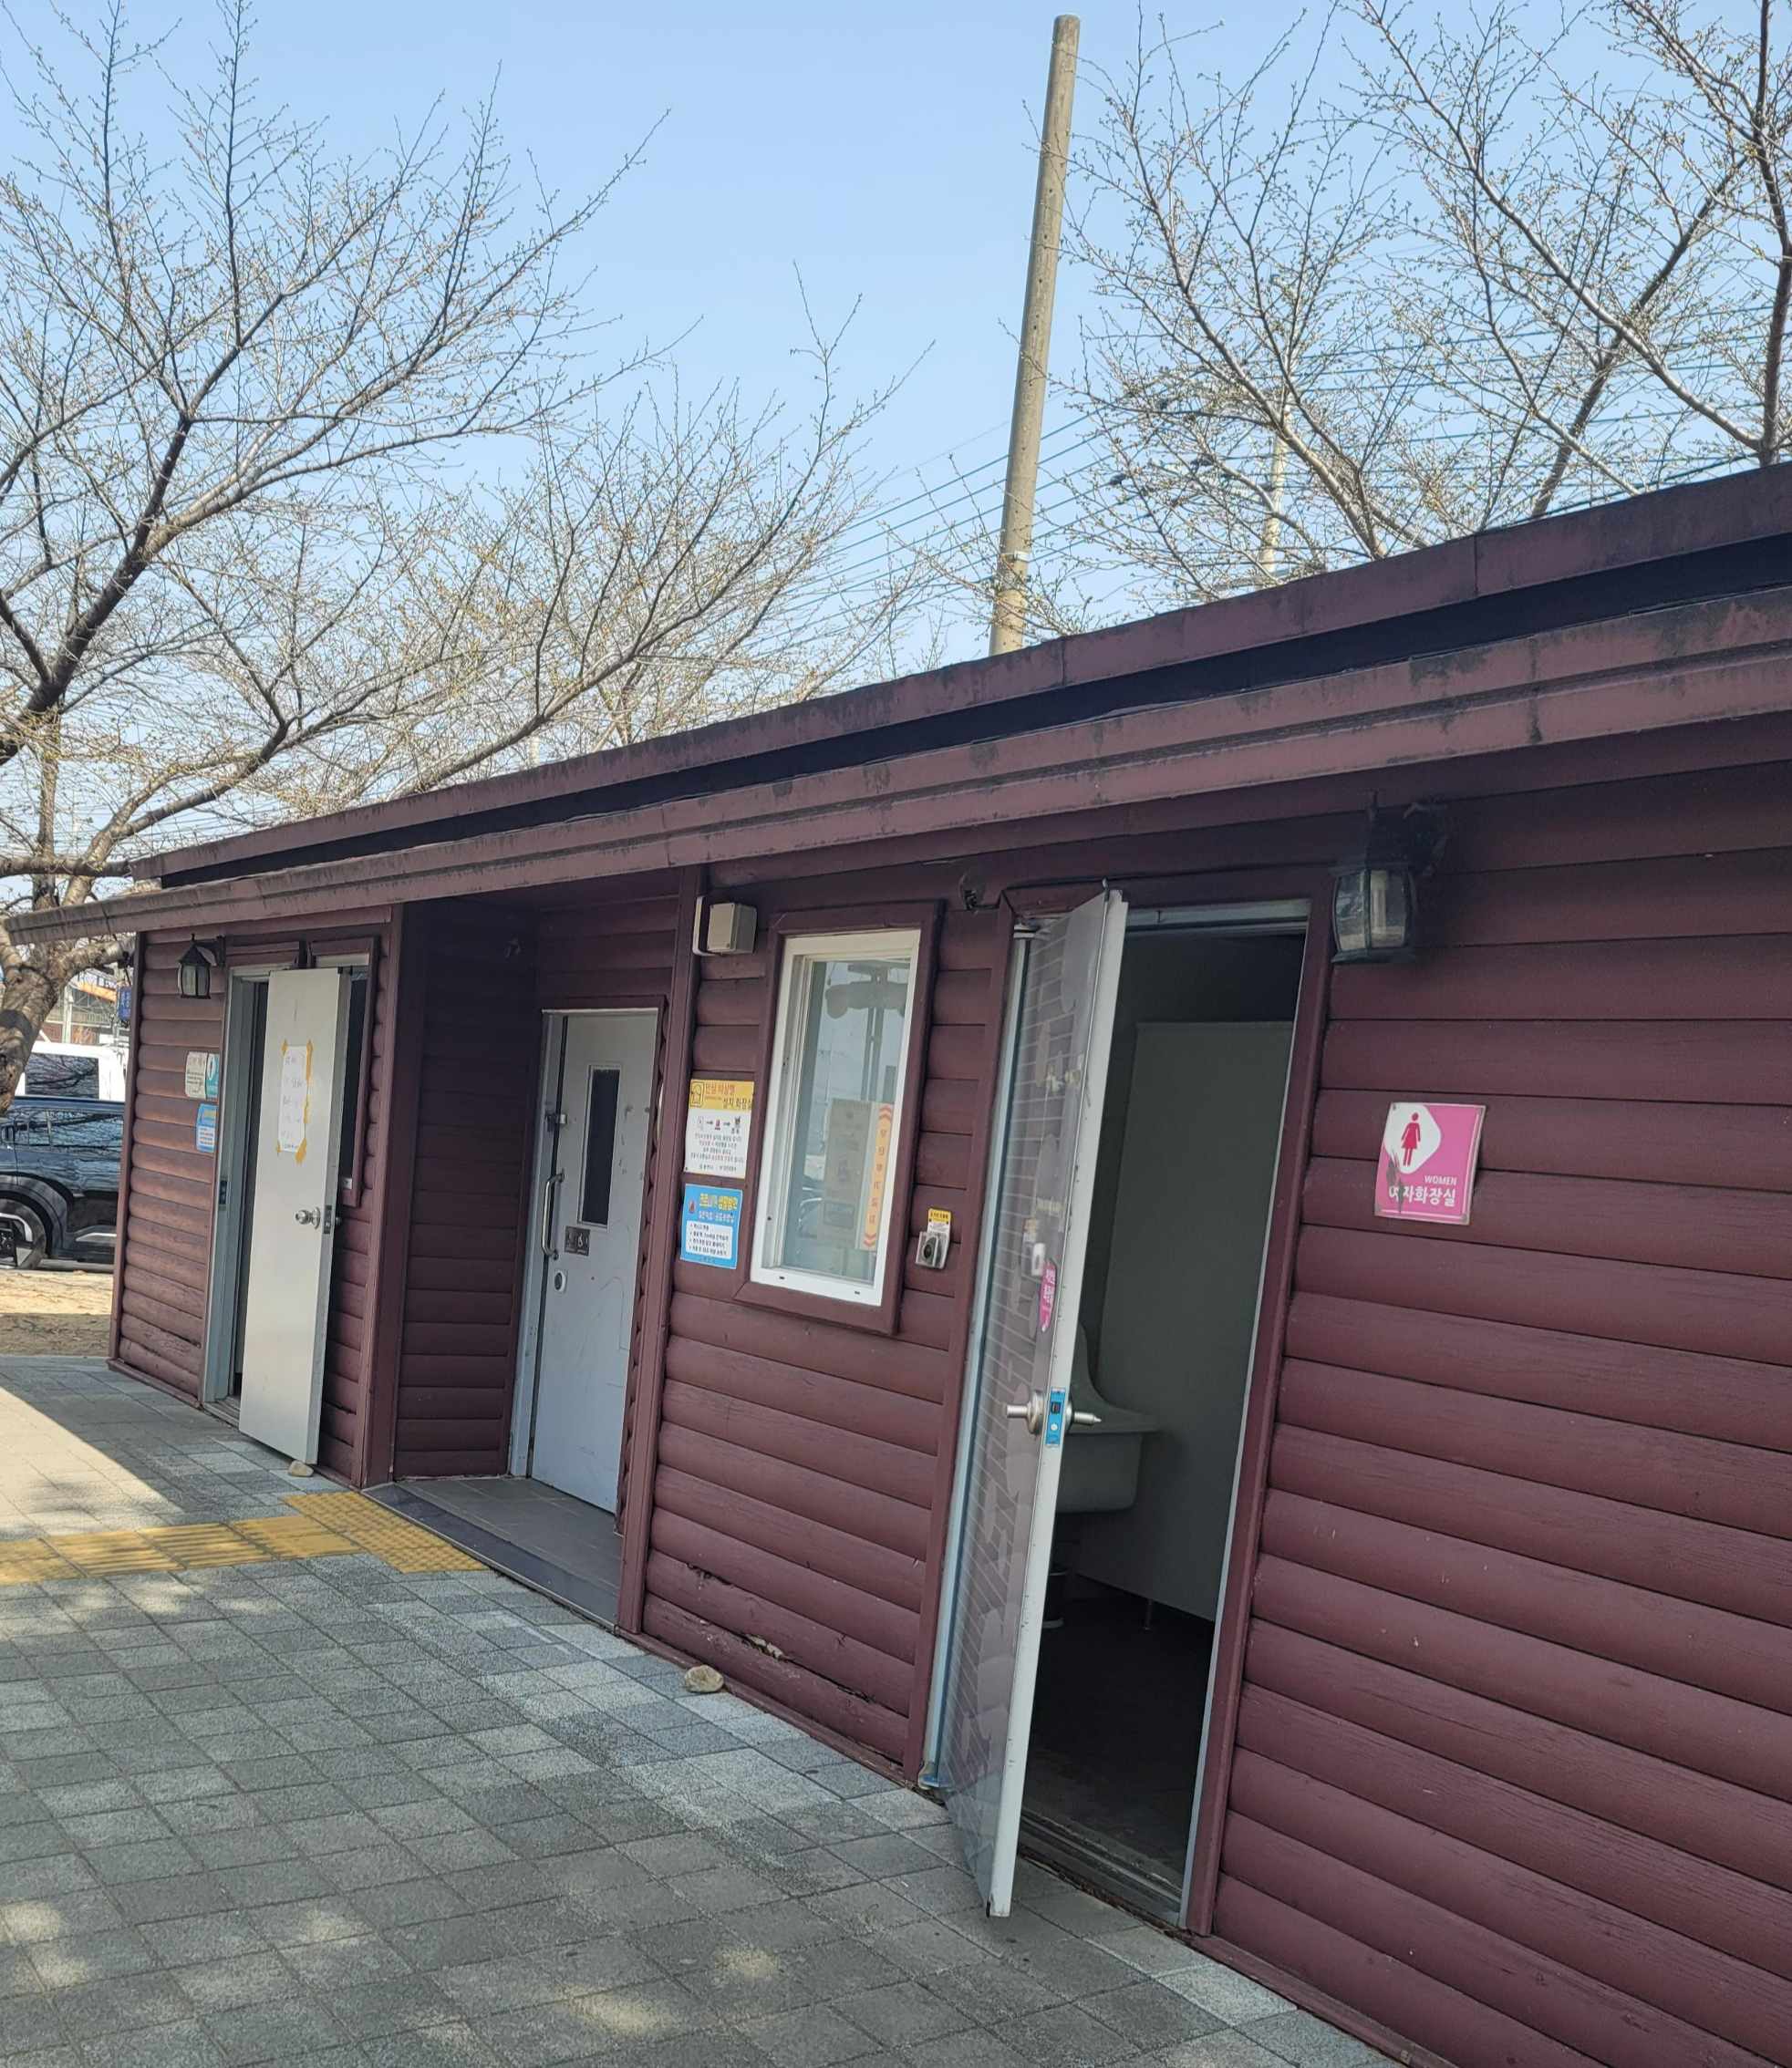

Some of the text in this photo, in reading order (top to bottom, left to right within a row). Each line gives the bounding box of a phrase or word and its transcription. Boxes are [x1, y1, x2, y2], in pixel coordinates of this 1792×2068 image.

[705, 1082, 735, 1096] 안심 비상벨
[722, 1096, 734, 1109] 설치
[1424, 1175, 1457, 1185] WOMEN
